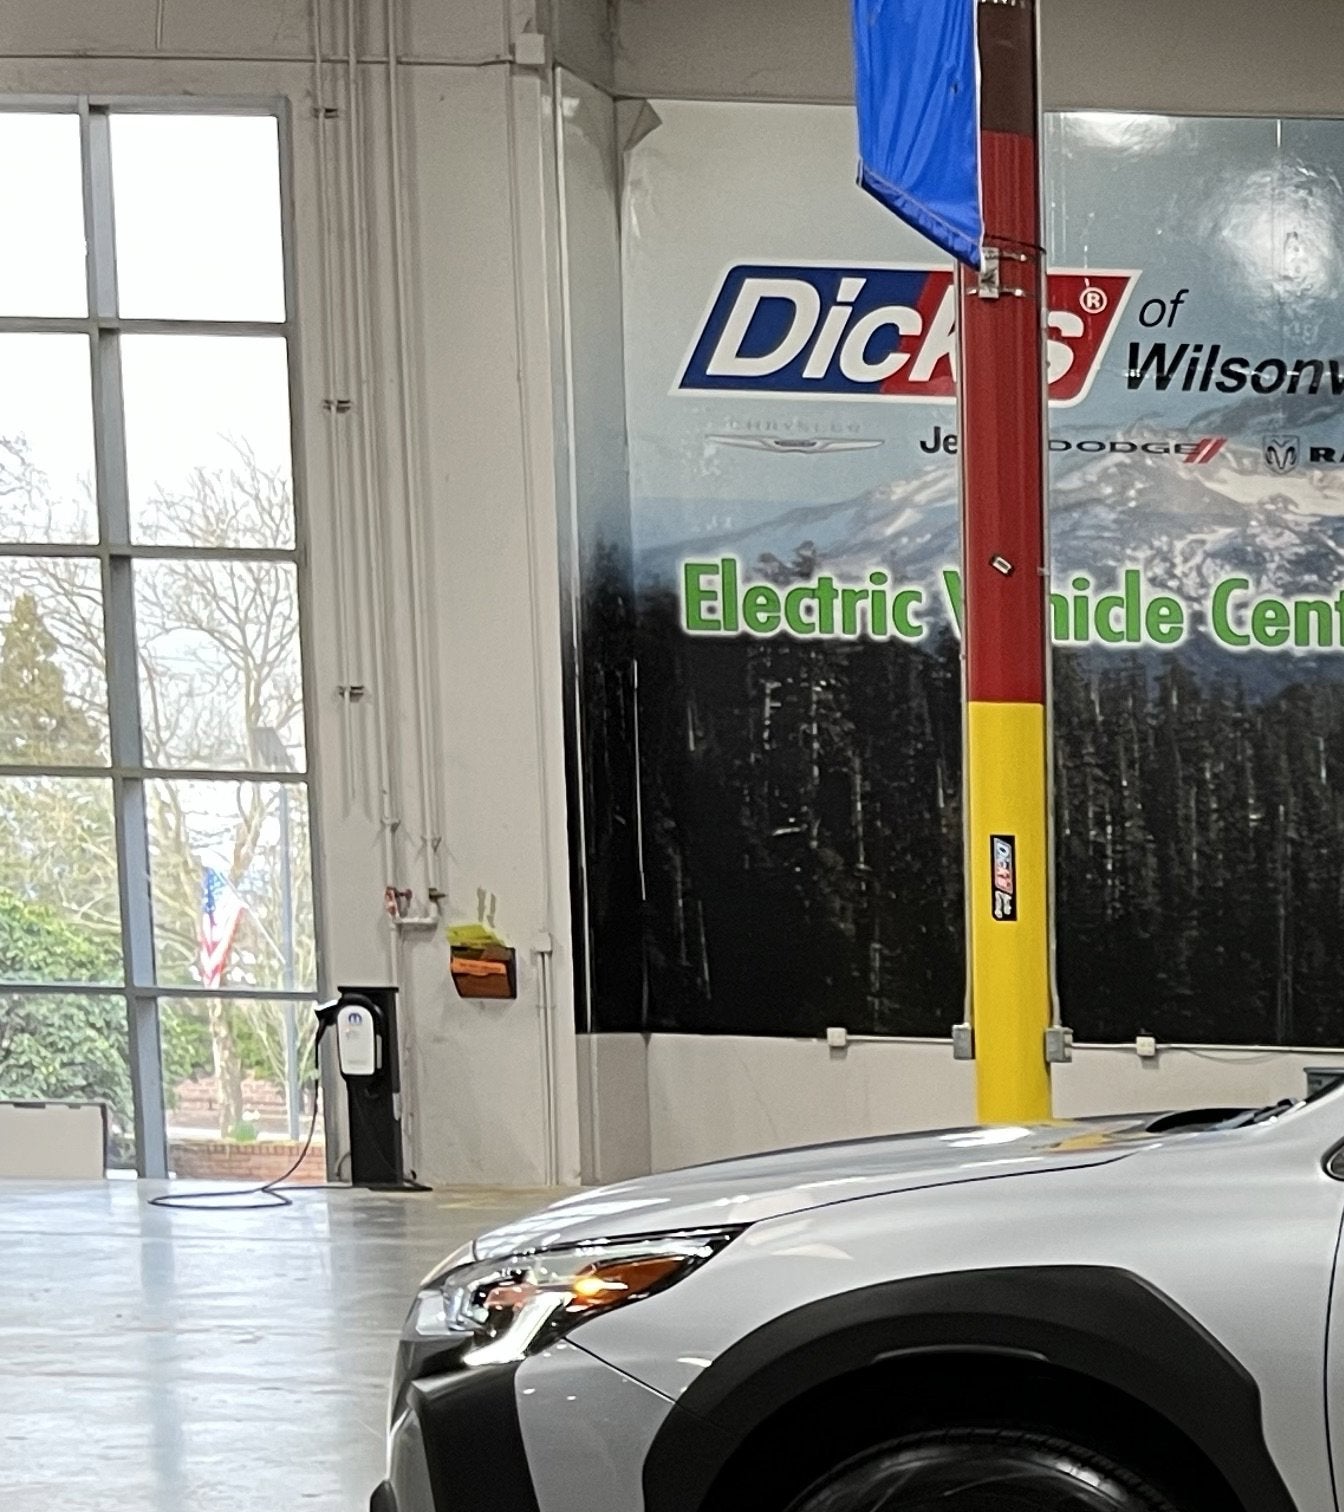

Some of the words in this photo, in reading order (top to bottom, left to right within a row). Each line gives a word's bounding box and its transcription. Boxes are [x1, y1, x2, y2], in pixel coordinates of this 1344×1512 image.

[1138, 289, 1189, 328] of
[1048, 440, 1201, 455] DODGE
[683, 558, 923, 638] Electric
